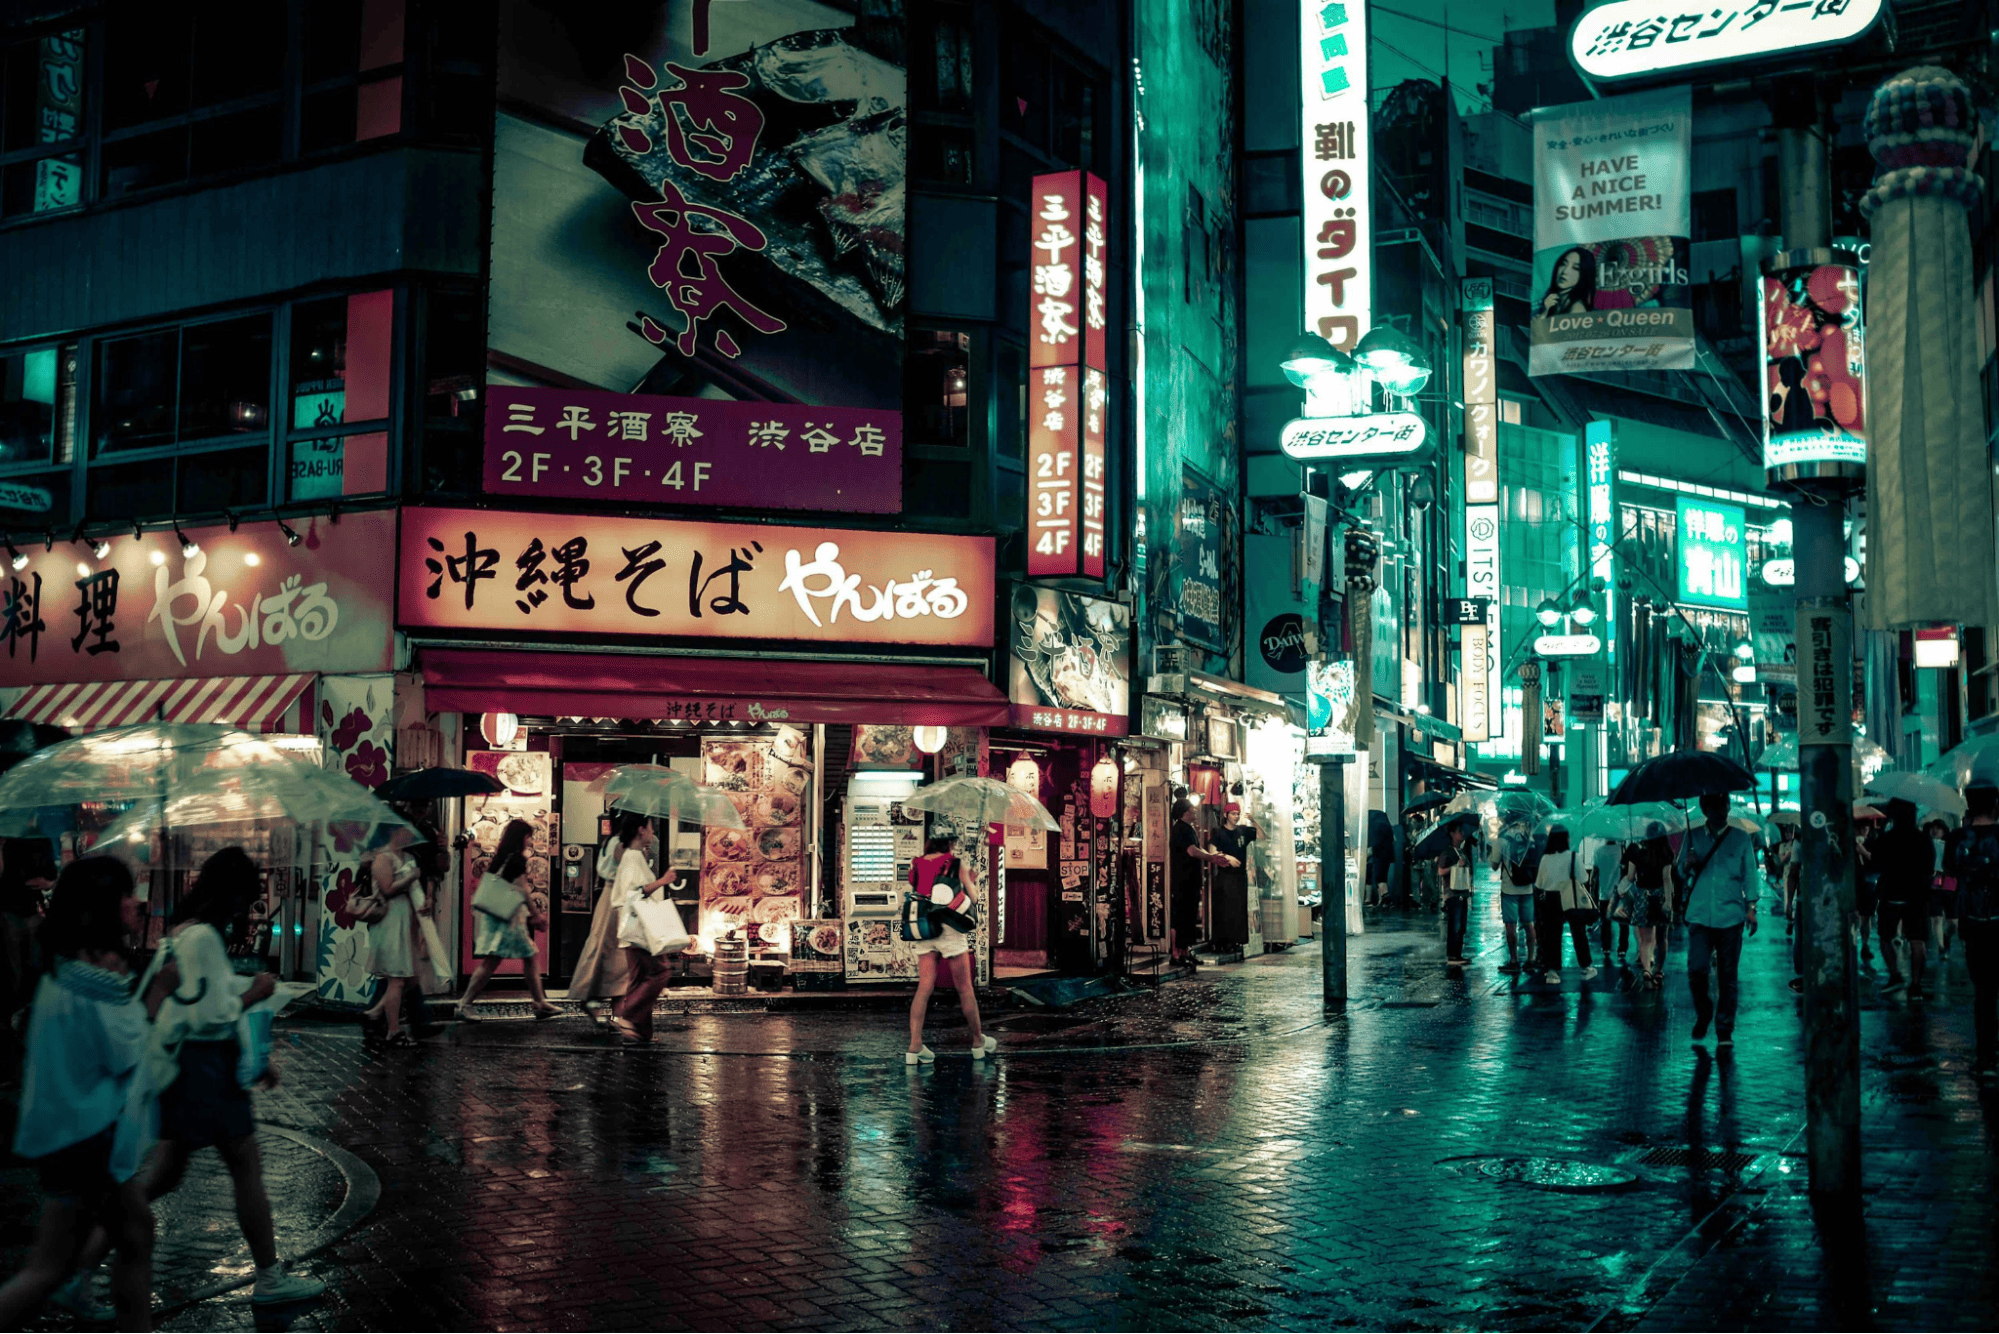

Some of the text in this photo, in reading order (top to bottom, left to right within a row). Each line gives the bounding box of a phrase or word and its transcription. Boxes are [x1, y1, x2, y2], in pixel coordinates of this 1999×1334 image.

[1586, 0, 1851, 57] 渋谷センター街
[1580, 155, 1639, 178] HAVE
[1571, 174, 1646, 200] A NICE
[1554, 194, 1662, 222] SUMMER!
[1314, 121, 1358, 352] 靴のダイワ
[1034, 194, 1079, 345] 三平酒寮
[1548, 308, 1675, 334] Love Queen
[1043, 367, 1067, 432] 渋谷店
[1469, 340, 1491, 478] カワノ・クォーク
[502, 403, 887, 457] 三平酒寮 渋谷店
[1288, 423, 1417, 447] 渋谷センター街
[1036, 451, 1071, 478] 2F
[1084, 452, 1104, 480] 2F
[1036, 491, 1070, 518] 3F
[1083, 491, 1103, 519] 3F
[1036, 530, 1070, 556] 4F
[1083, 530, 1103, 558] 4F
[425, 530, 968, 628] 沖縄そば やんばる
[0, 549, 339, 668] 料理 やんばる
[1262, 632, 1305, 651] DAIW
[1472, 638, 1485, 730] BODY FOCUS
[666, 701, 737, 719] 沖縄そば
[1061, 864, 1088, 876] STOP
[1149, 863, 1161, 873] 5F
